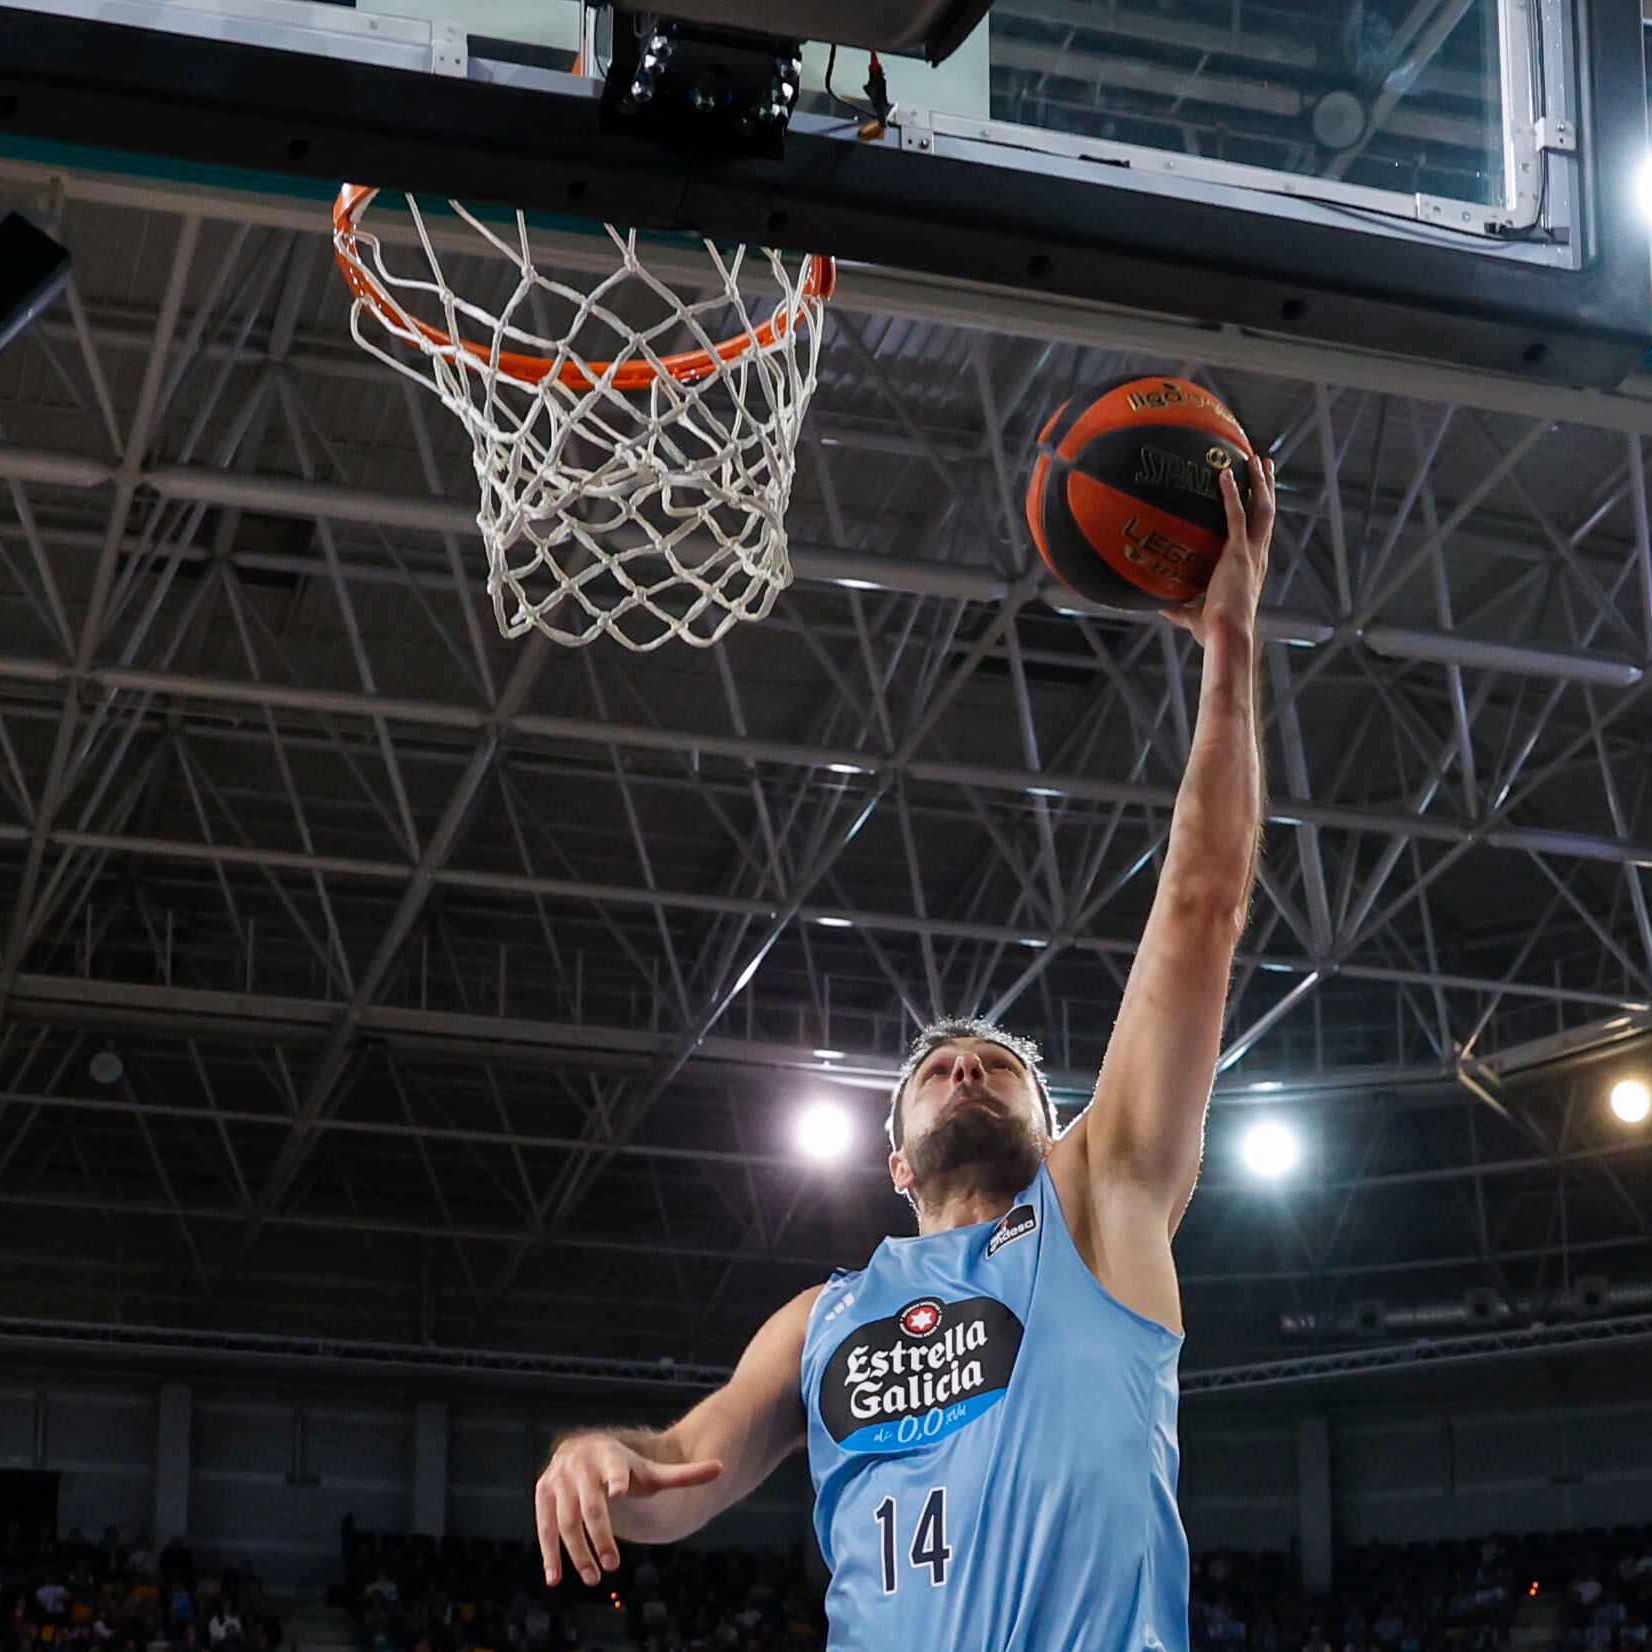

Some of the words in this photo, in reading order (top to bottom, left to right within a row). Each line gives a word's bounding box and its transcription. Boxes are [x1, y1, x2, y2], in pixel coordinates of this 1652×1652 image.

[1134, 446, 1218, 500] SPAL
[844, 1319, 988, 1386] Estrella
[850, 1358, 984, 1420] Galicia
[898, 1407, 943, 1444] 0,0
[873, 1486, 952, 1596] 14
